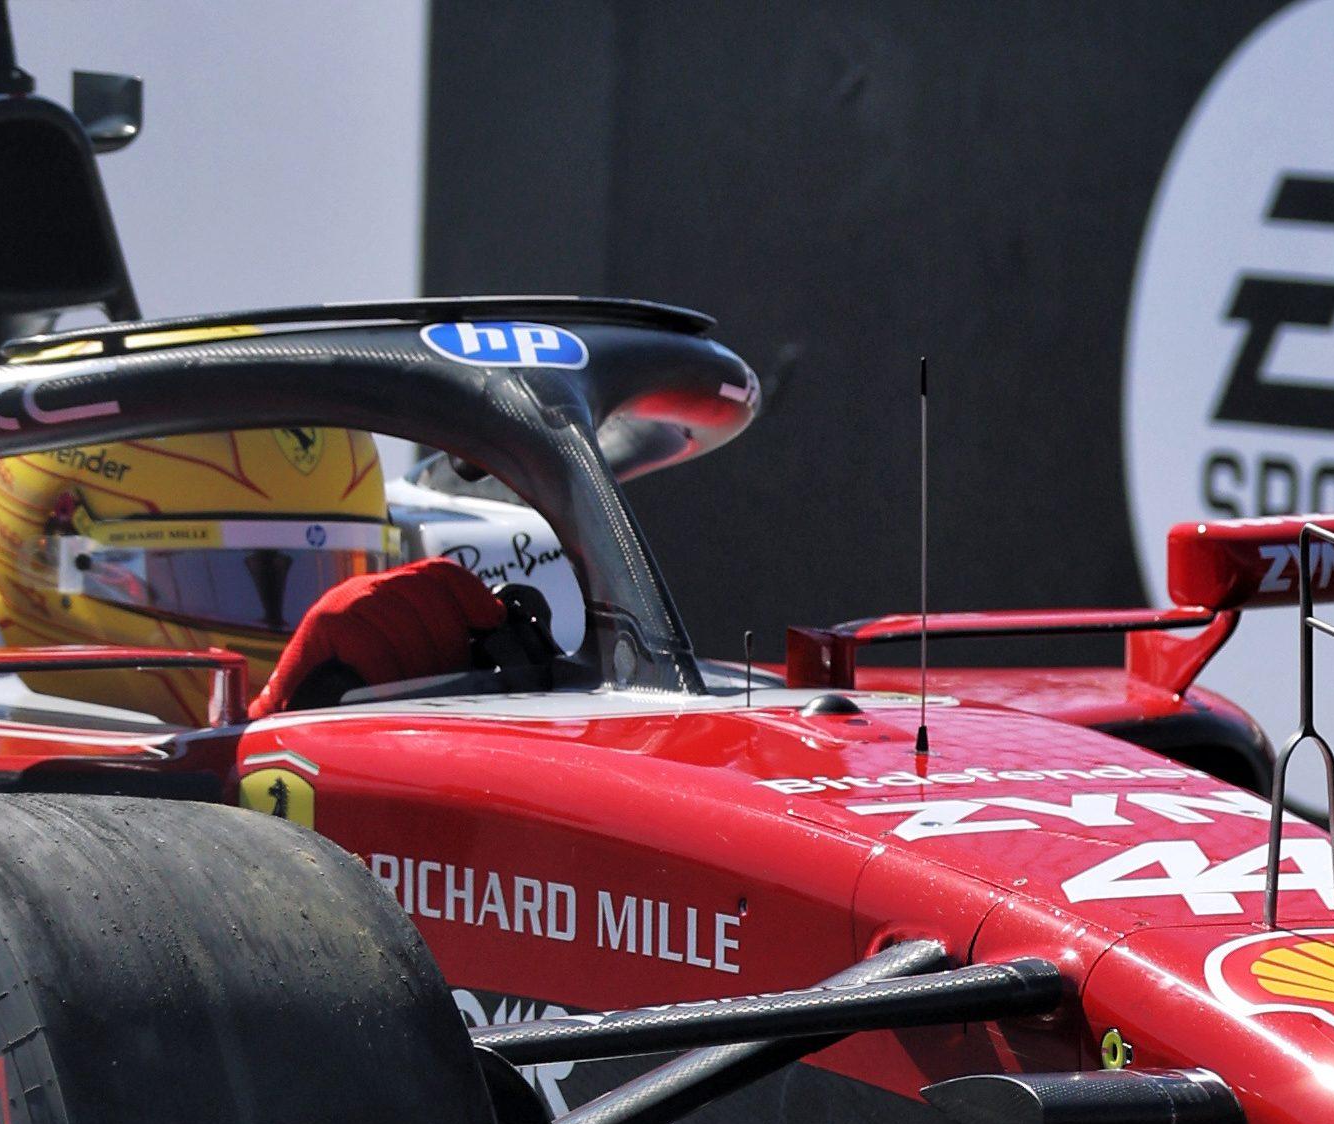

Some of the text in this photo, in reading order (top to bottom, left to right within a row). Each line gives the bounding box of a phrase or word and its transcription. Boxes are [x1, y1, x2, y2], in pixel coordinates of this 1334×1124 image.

[455, 322, 560, 365] hp
[846, 789, 1310, 843] ZYN
[596, 890, 741, 975] MILLE
